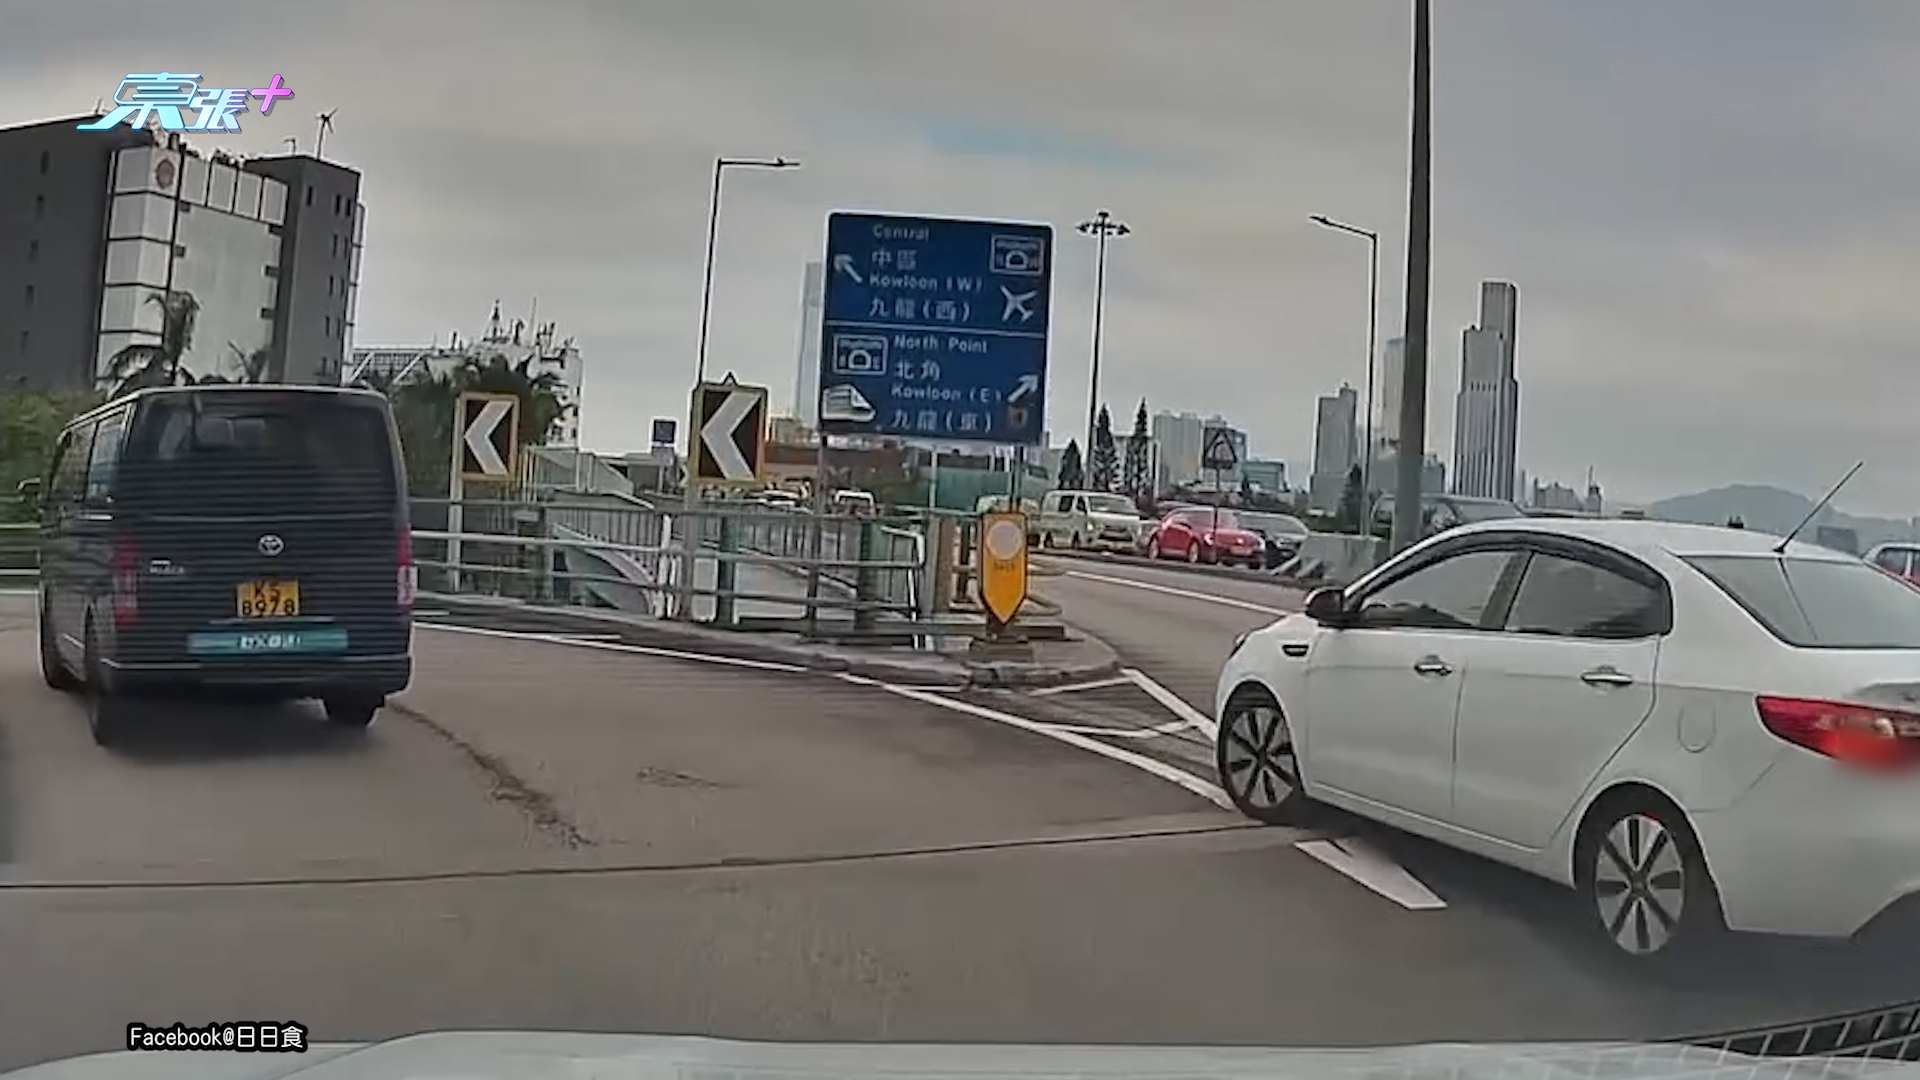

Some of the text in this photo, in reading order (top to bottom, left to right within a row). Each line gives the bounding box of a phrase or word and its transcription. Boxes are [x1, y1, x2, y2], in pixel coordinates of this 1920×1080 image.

[872, 223, 930, 242] Central
[871, 248, 918, 271] 中區
[869, 272, 938, 292] Kowloon
[893, 333, 988, 353] North Point
[892, 359, 940, 381] 北角
[889, 382, 962, 401] Kowloon
[242, 599, 296, 616] 8978
